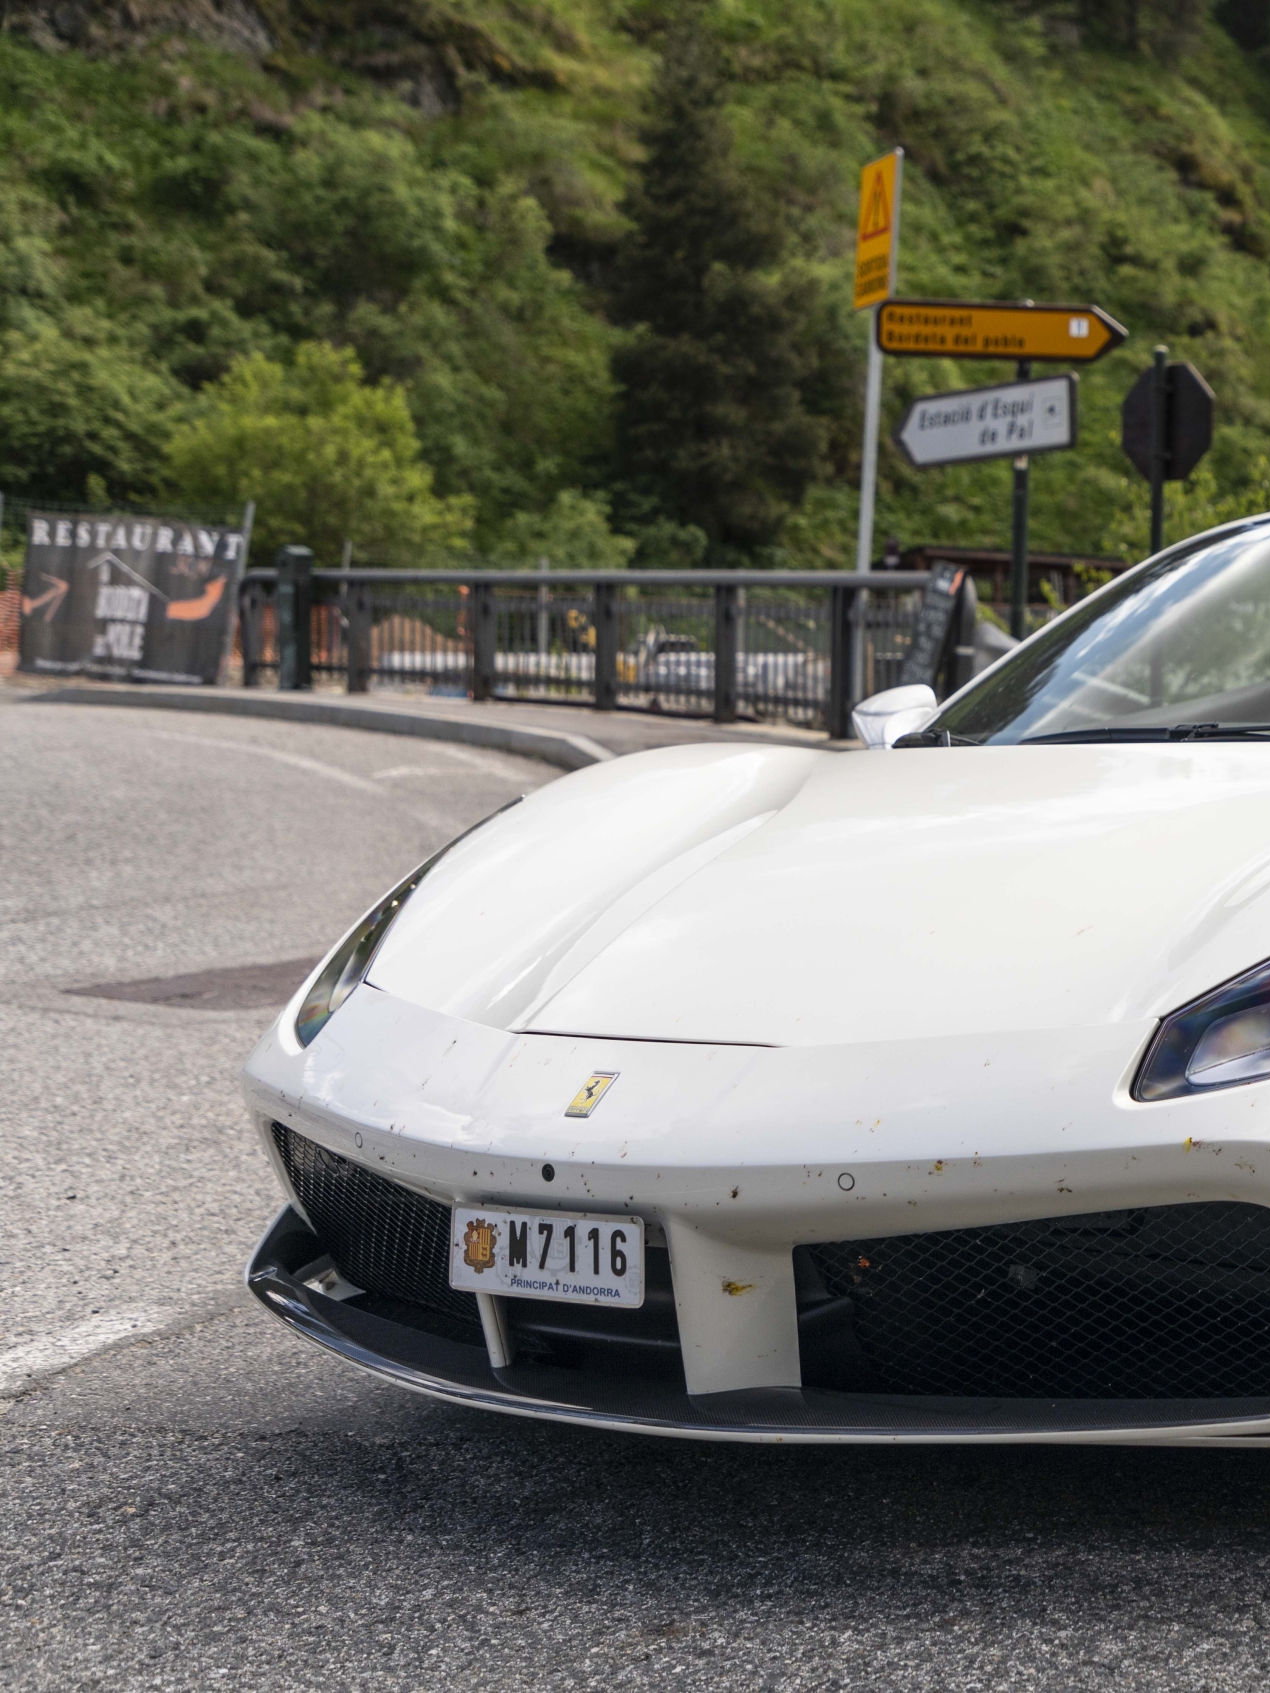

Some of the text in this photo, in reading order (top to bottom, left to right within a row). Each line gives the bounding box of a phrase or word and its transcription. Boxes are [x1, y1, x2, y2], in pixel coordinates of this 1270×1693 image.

[886, 311, 973, 328] Restaurant
[886, 329, 1026, 350] Bordeta del poble
[918, 402, 972, 431] Estació
[979, 417, 1034, 447] de Pal
[31, 518, 243, 560] RESTAURANT
[508, 1220, 627, 1277] M7116
[510, 1278, 621, 1298] PRINCIPAT D'ANDORRA
